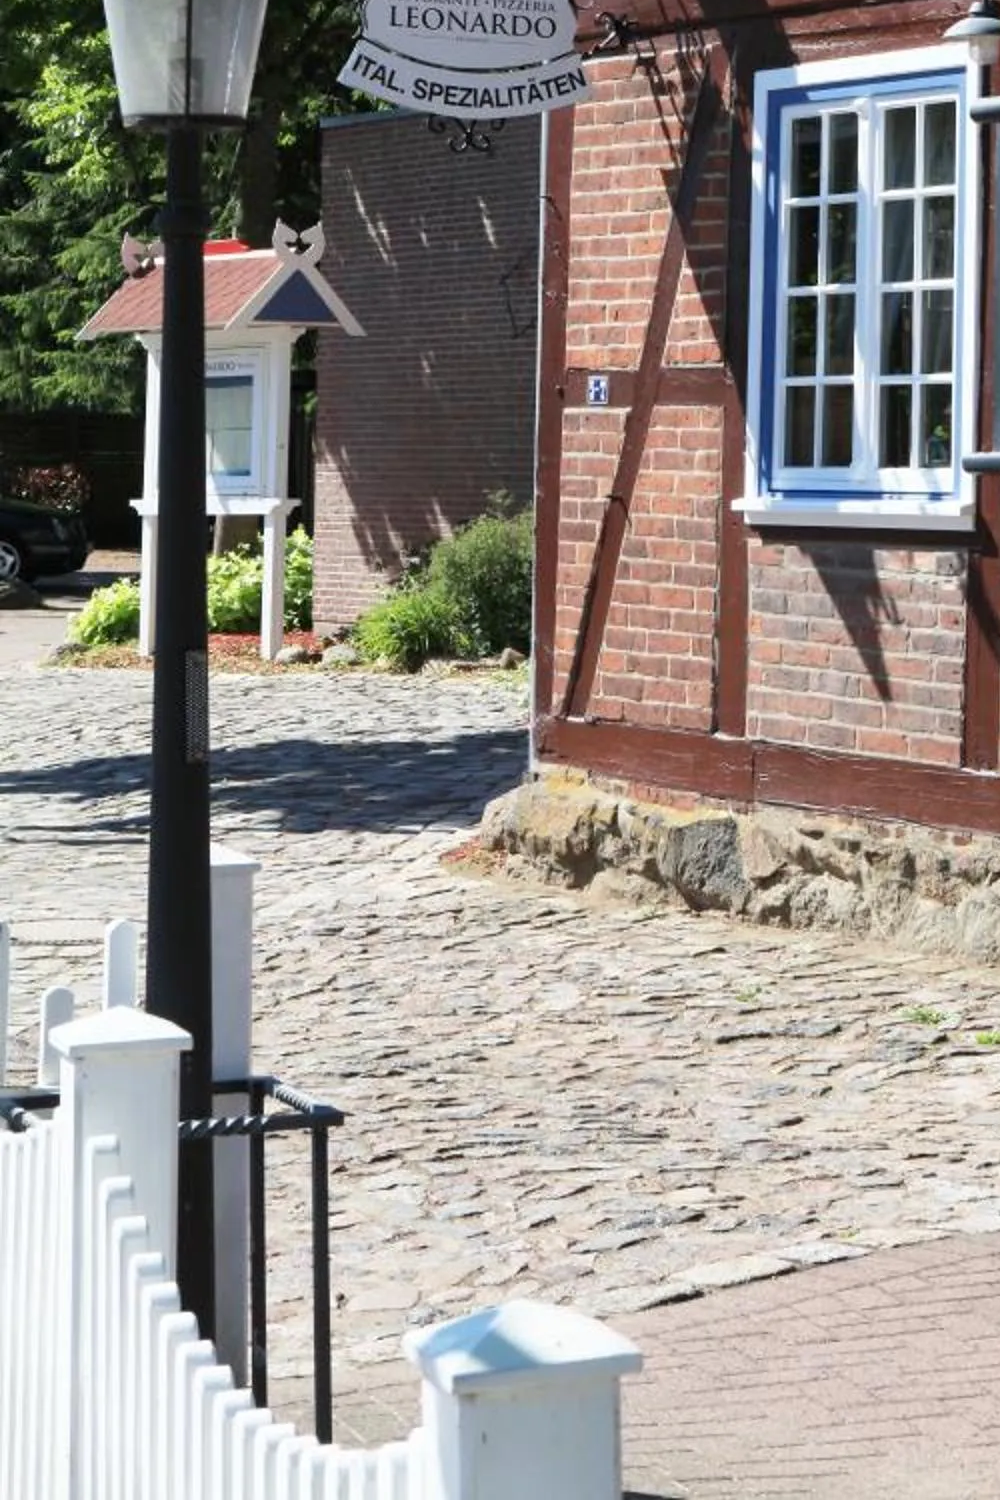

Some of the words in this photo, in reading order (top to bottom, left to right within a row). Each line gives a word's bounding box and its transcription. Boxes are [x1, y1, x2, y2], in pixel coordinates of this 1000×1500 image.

[390, 5, 558, 40] LEONARDO
[351, 52, 406, 96] ITAL.
[411, 67, 588, 109] SPEZIALITÄTEN
